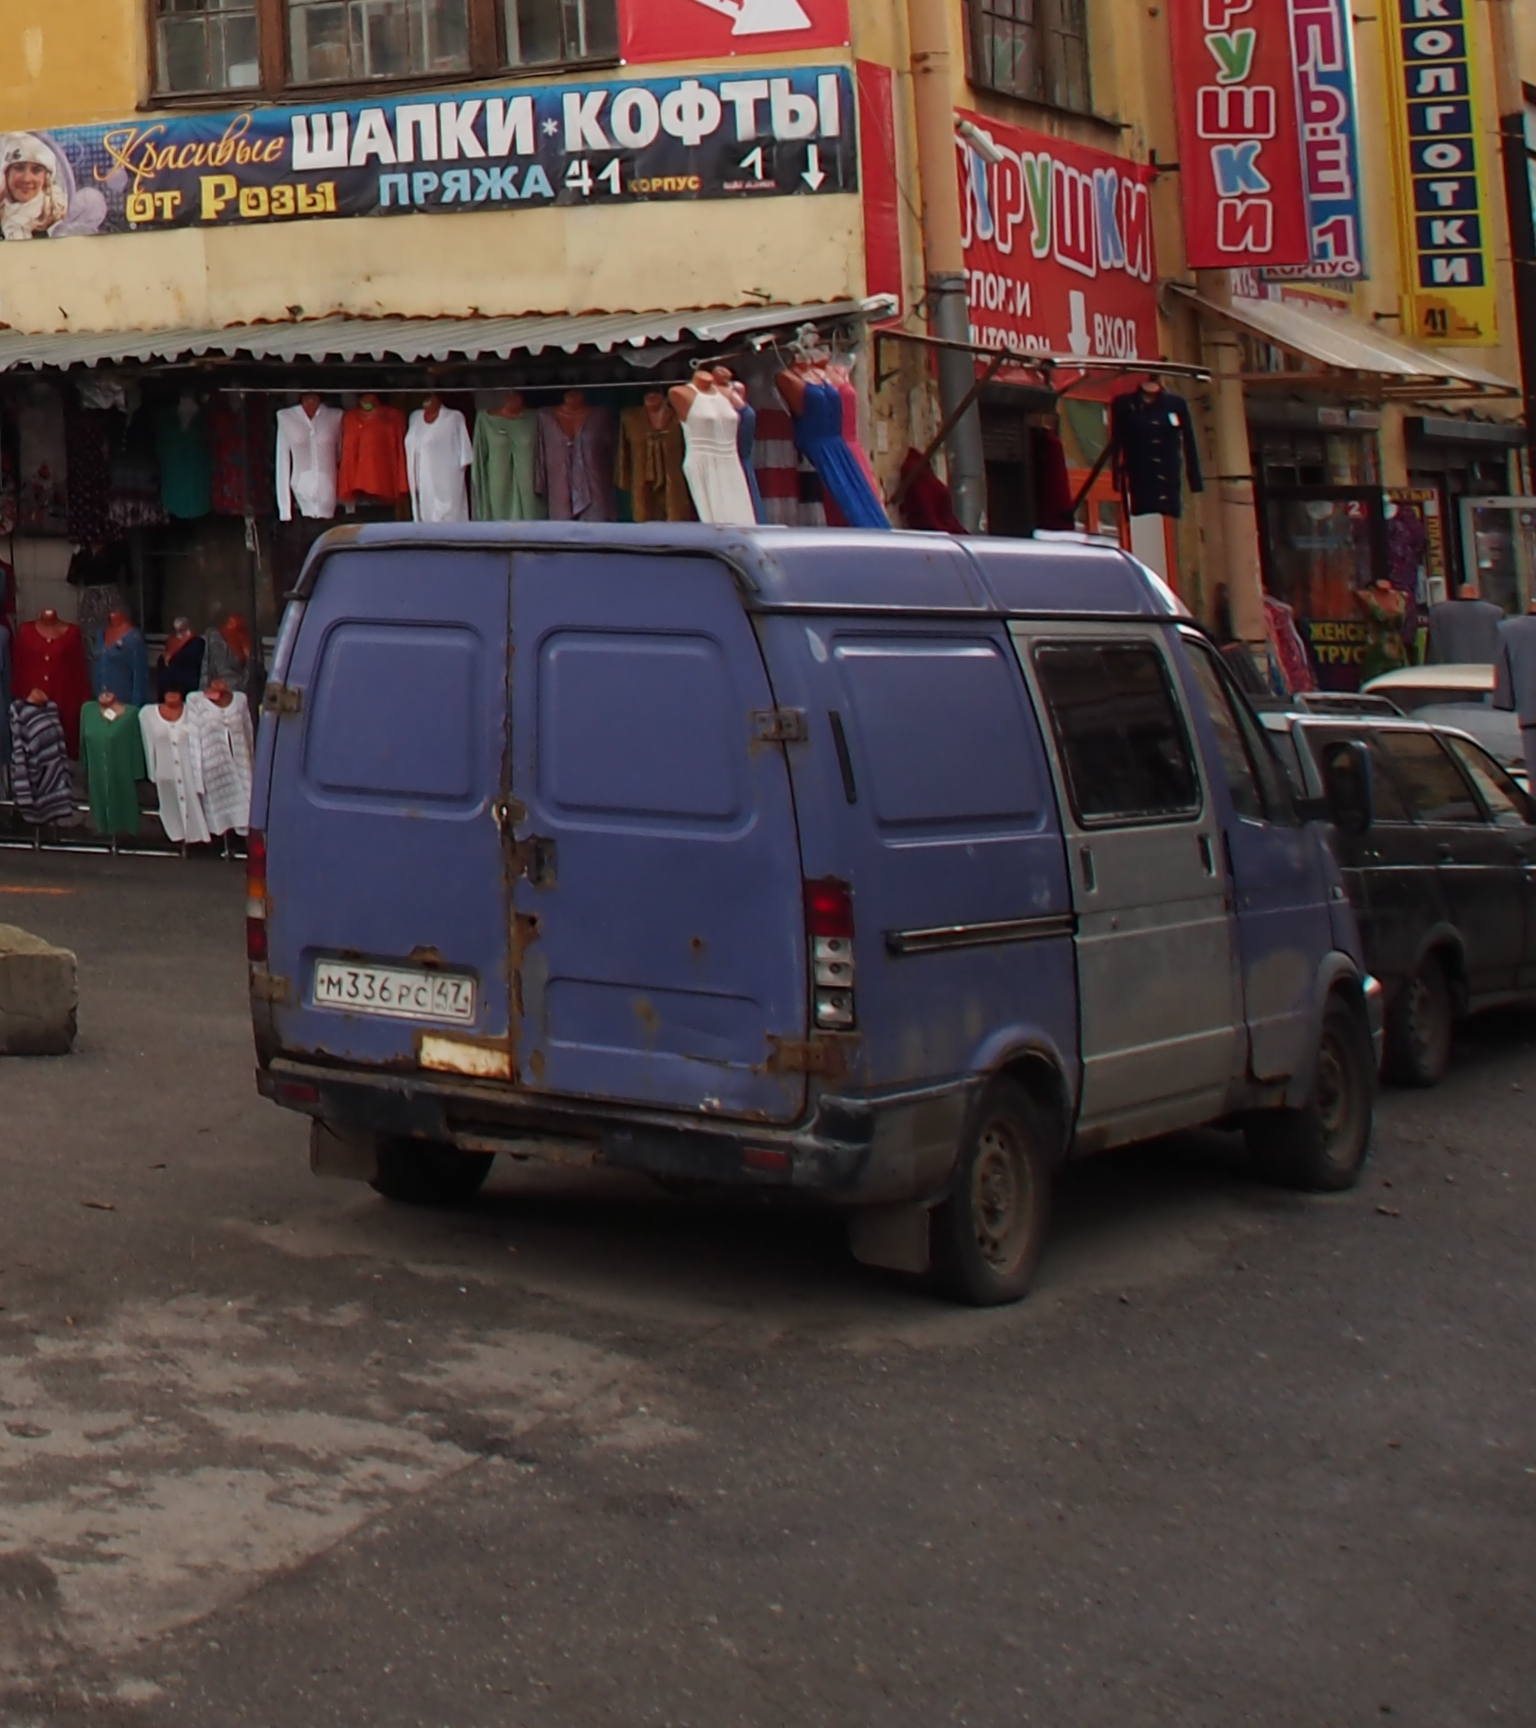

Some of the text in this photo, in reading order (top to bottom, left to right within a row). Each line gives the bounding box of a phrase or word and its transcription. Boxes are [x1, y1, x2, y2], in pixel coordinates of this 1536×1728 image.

[93, 74, 842, 195] Красивые ШАПКИ КОФТЫ
[199, 174, 338, 221] Розы
[378, 164, 555, 207] ПРЯЖА
[564, 157, 623, 197] 41
[629, 175, 701, 193] КОРПУС
[738, 146, 765, 181] 1
[1315, 215, 1353, 261] 1
[1094, 313, 1138, 361] ВХОД
